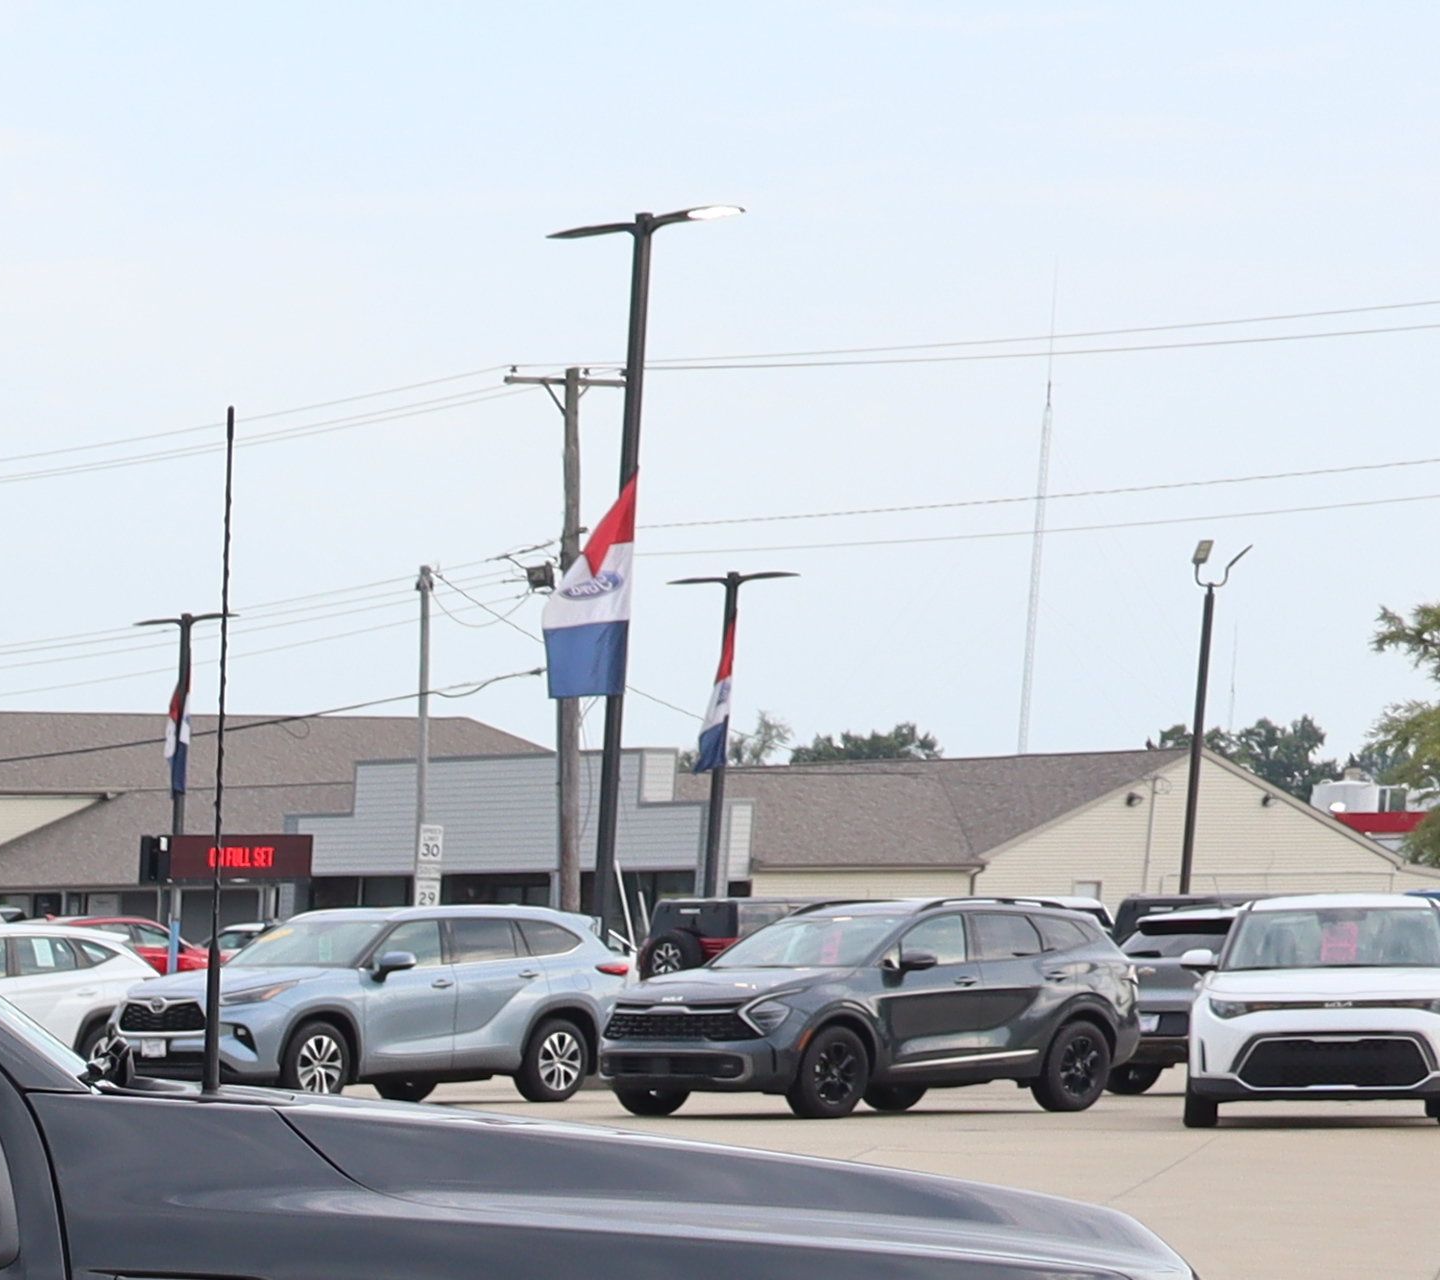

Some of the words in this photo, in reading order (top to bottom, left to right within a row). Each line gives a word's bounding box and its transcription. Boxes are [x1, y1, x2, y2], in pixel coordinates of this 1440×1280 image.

[225, 846, 251, 868] FULL
[253, 846, 275, 868] SET
[421, 843, 440, 857] 30
[419, 892, 435, 905] 29
